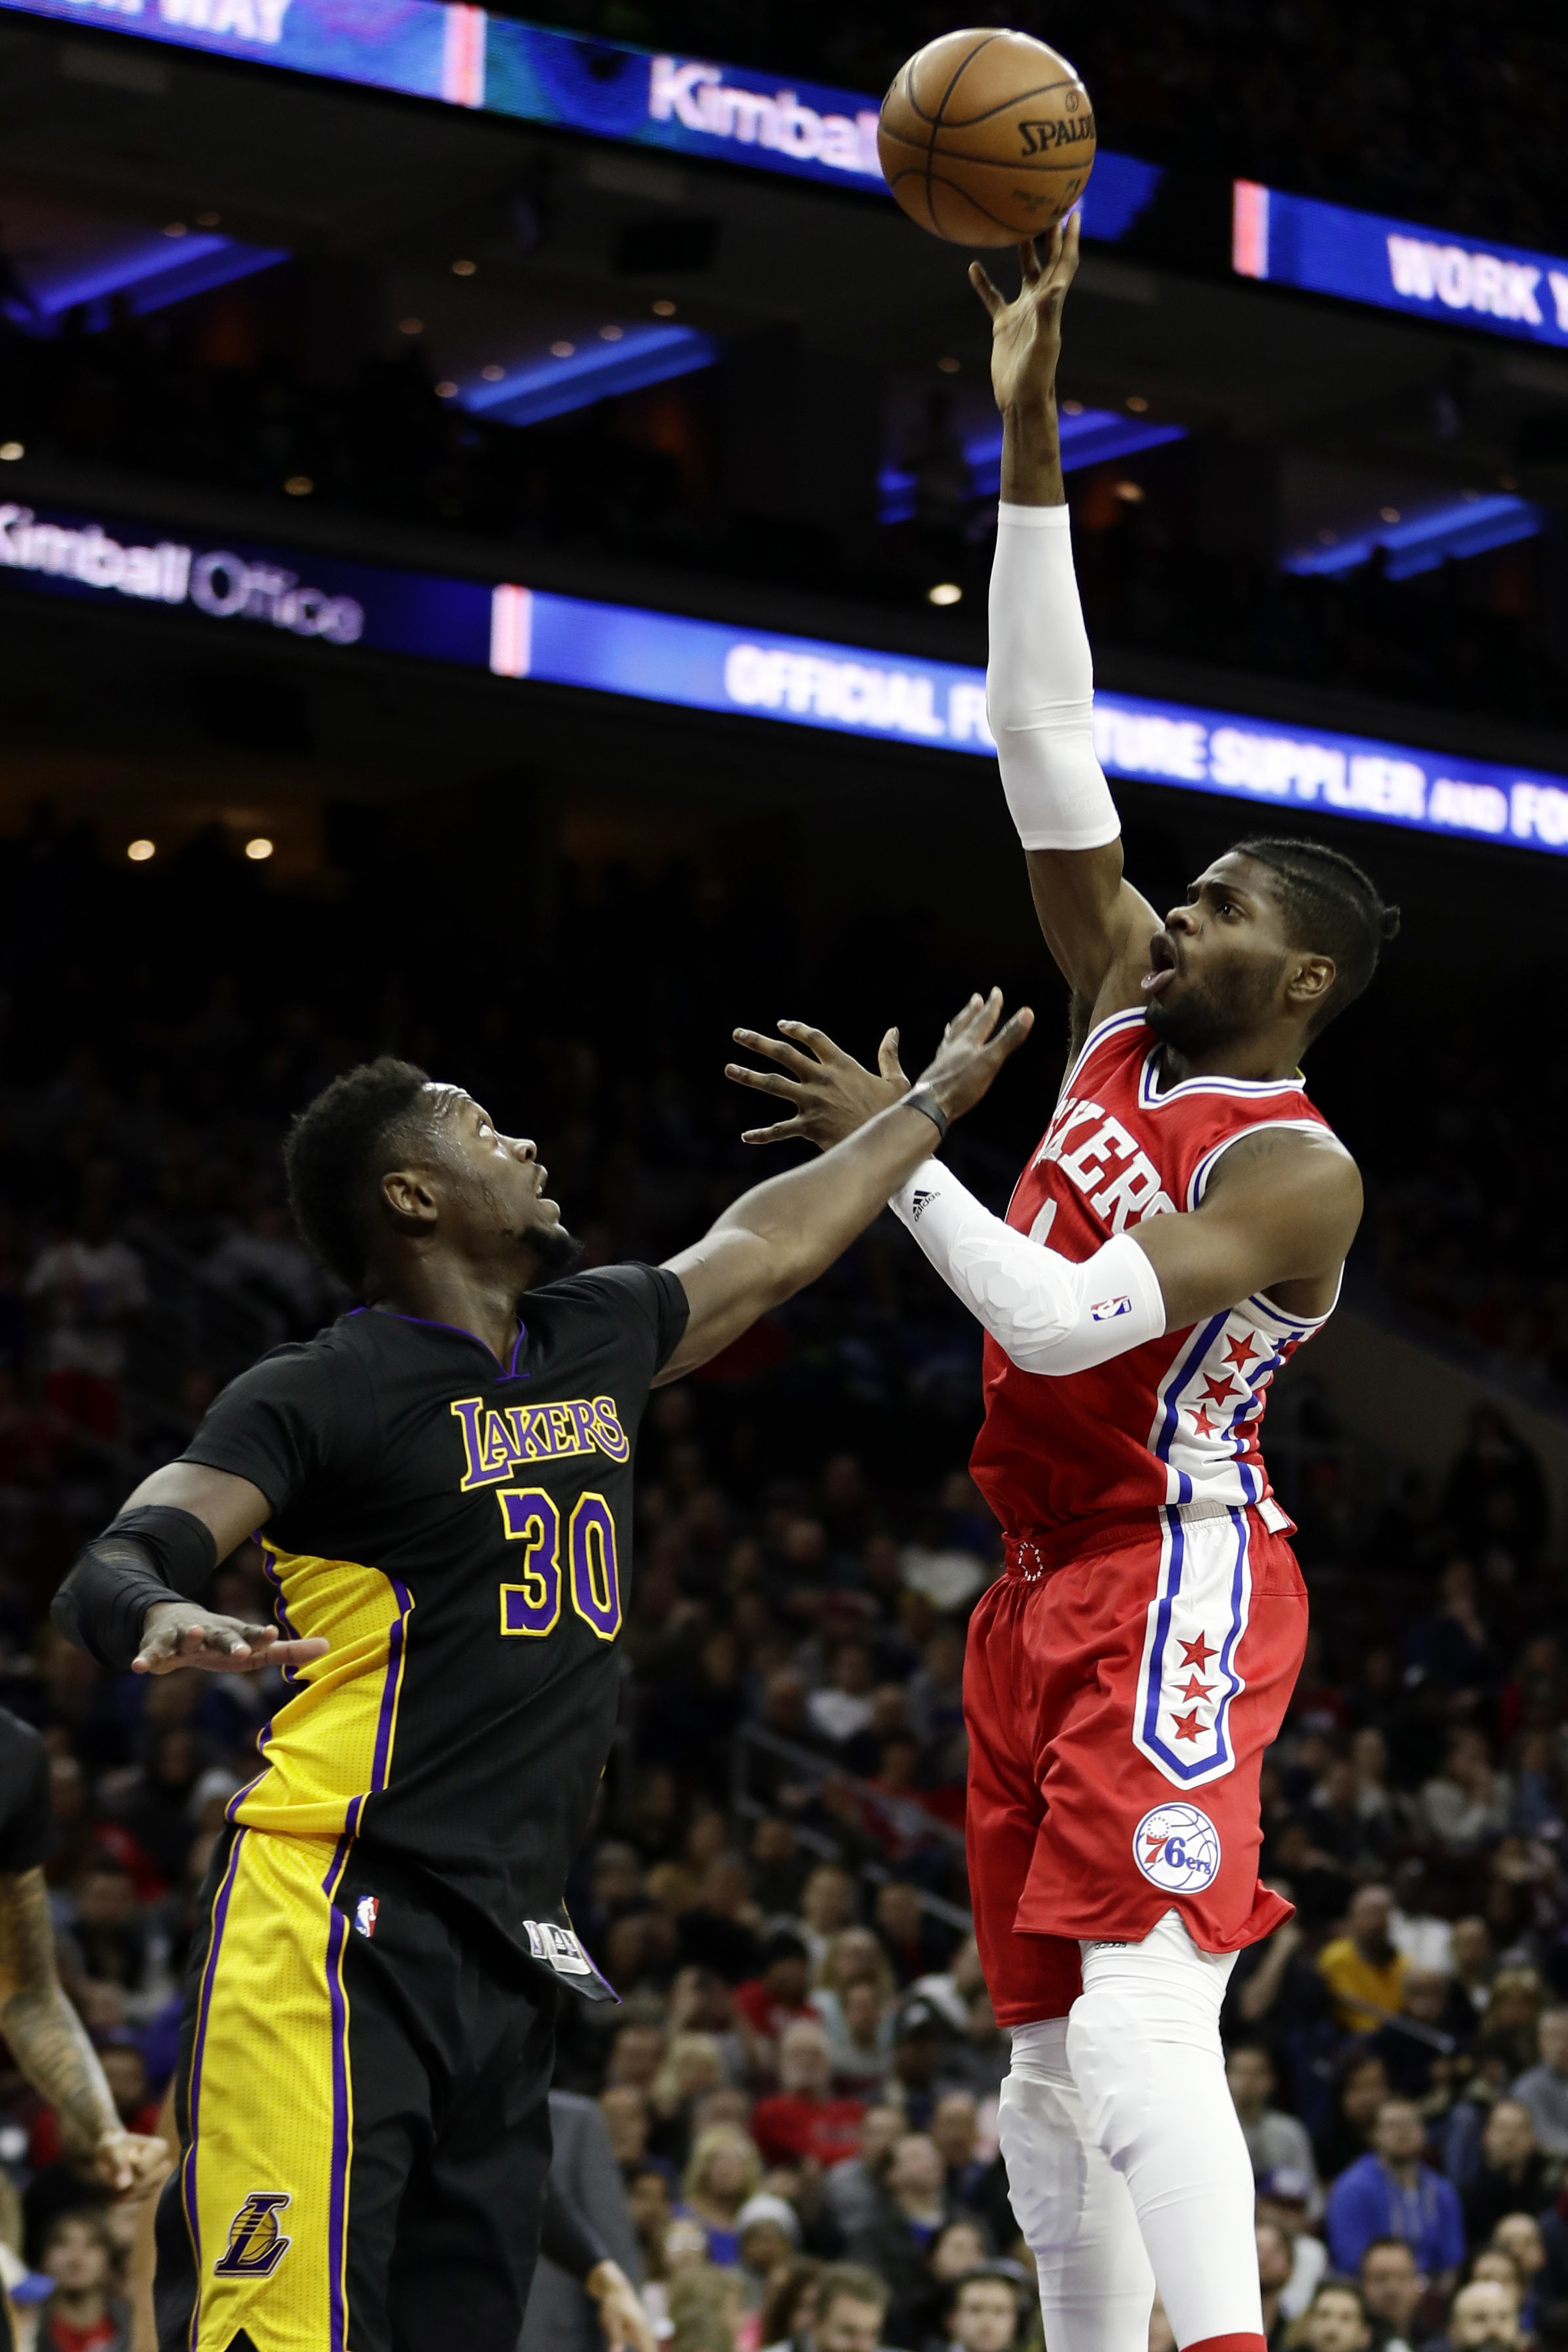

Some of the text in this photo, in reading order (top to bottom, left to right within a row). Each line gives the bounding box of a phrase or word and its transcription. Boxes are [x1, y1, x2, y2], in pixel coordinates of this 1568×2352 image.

[648, 54, 884, 177] Kimbal
[1387, 234, 1543, 326] WORK
[724, 644, 945, 737] OFFICIAL
[1209, 726, 1426, 821] SUPPLIER
[1429, 778, 1508, 834] AND
[914, 1191, 941, 1222] adidas
[450, 1395, 630, 1493] LAKERS
[495, 1487, 623, 1642] 30
[1144, 1832, 1212, 1875] 76ers
